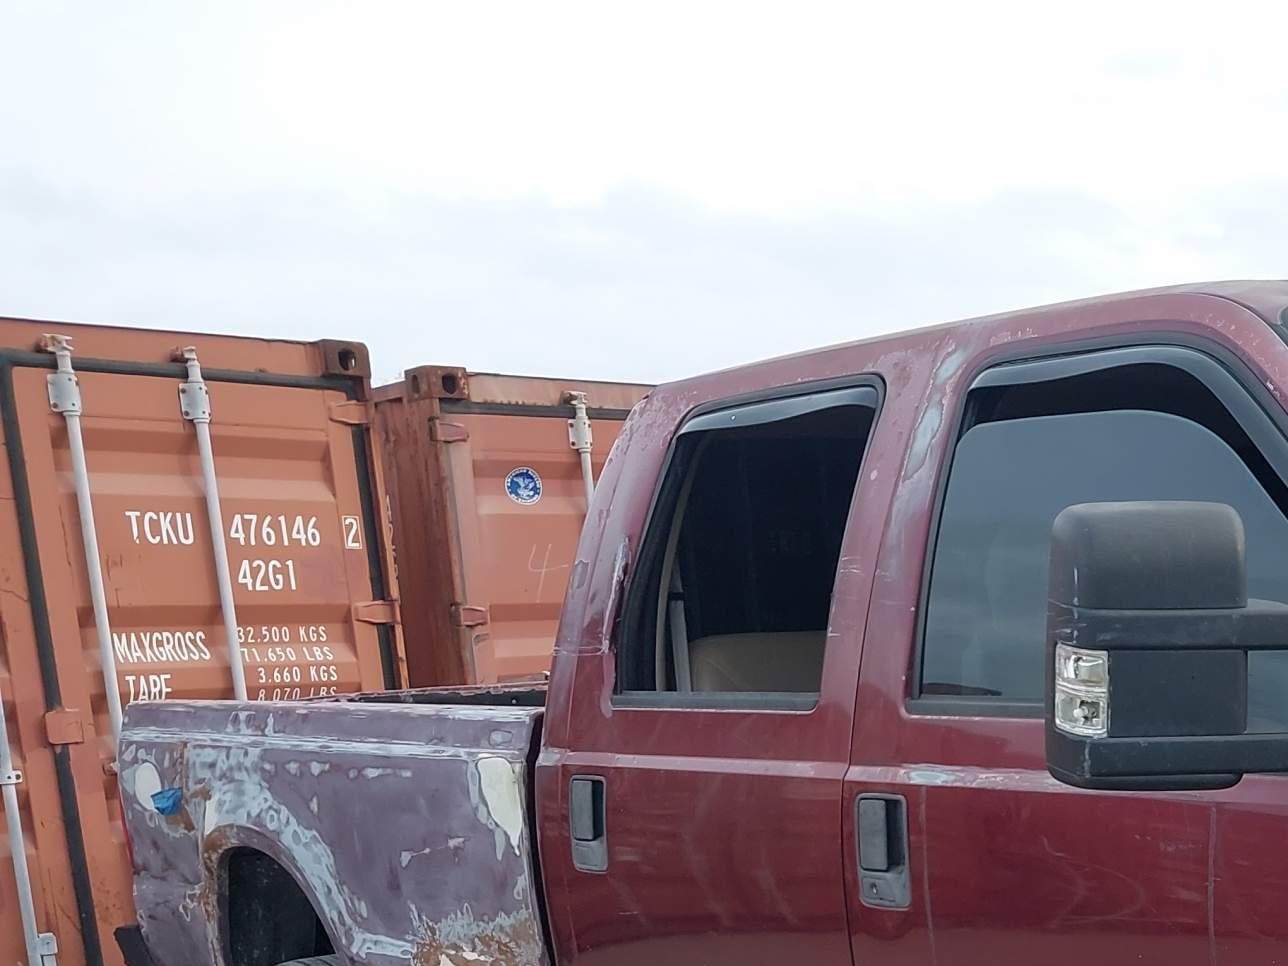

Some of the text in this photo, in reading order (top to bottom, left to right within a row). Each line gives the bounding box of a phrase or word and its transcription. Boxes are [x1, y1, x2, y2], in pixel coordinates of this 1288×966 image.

[125, 511, 361, 548] TCKU 476146 2
[238, 559, 297, 591] 42G1
[112, 625, 327, 663] MAXGROSS 32.500 KGS
[240, 646, 334, 662] 71.650 LBS
[257, 666, 301, 683] 3.660
[310, 665, 338, 682] KGS
